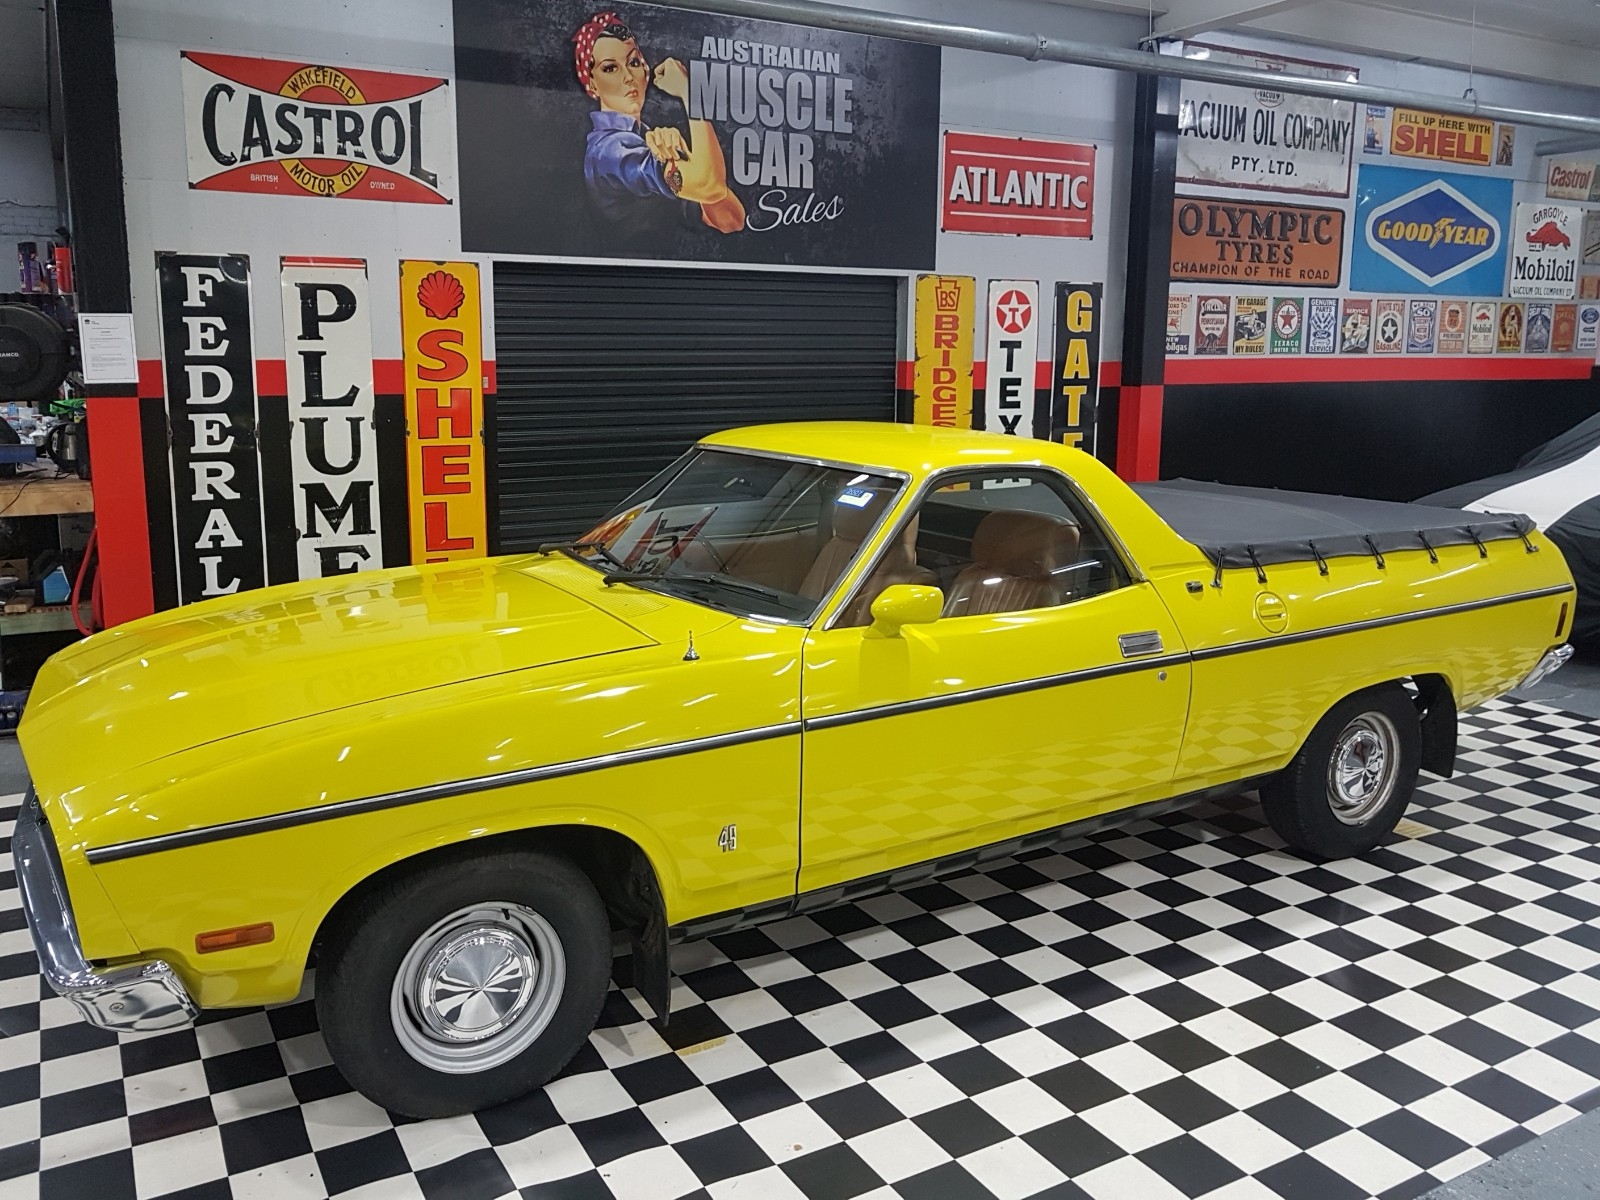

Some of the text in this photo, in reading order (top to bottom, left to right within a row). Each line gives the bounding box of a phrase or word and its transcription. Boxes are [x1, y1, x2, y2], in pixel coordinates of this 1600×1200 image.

[701, 36, 841, 74] AUSTRALIAN
[288, 67, 356, 99] WAKEFIELD
[689, 60, 853, 133] MUSCLE
[1253, 108, 1278, 147] OIL
[1283, 113, 1351, 155] COMPANY
[1399, 112, 1420, 125] FILL
[1422, 116, 1436, 126] UP
[1438, 118, 1465, 131] HERE
[1467, 122, 1491, 134] WITH
[202, 83, 438, 189] CASTROL
[1394, 125, 1489, 162] SHELL
[732, 127, 814, 189] CAR
[1231, 155, 1298, 177] PTY. LTD.
[250, 173, 396, 190] BRITISH OWNED
[290, 161, 363, 193] MOTOR OIL
[949, 165, 1088, 210] ATLANTIC
[1551, 166, 1592, 190] Castrol
[746, 189, 844, 231] Sales
[1533, 206, 1568, 227] GARGOYLE
[1178, 202, 1333, 245] OLYMPIC
[1216, 240, 1294, 265] TYRES
[1172, 262, 1330, 280] CHAMPION OF THE ROAD
[1514, 256, 1575, 282] Mobiloil
[939, 291, 956, 308] BS
[1200, 300, 1227, 313] SINCLAIR
[1237, 298, 1246, 306] MY
[1311, 298, 1337, 306] GENUINE
[1009, 308, 1019, 323] T
[1235, 345, 1244, 353] MY
[1309, 345, 1332, 353] SERVICE
[1375, 341, 1401, 351] GASOLINE
[932, 314, 960, 427] BRIDGE
[180, 266, 243, 596] FEDERAL
[415, 328, 475, 562] SHEL
